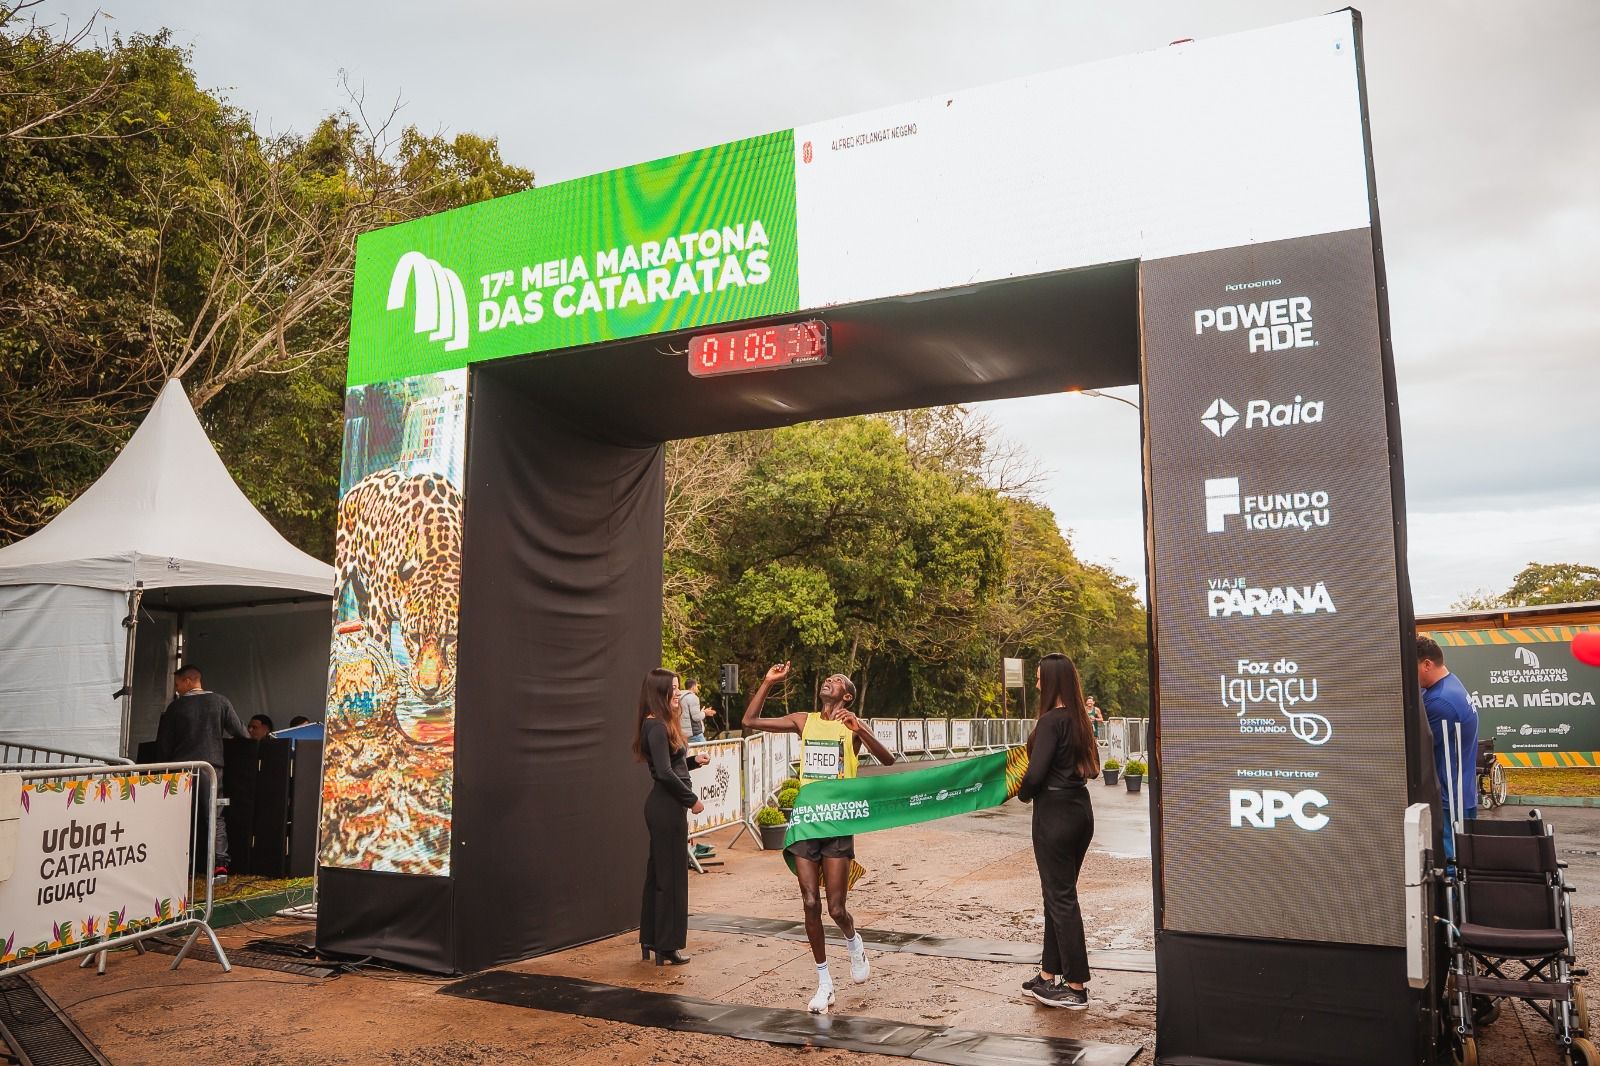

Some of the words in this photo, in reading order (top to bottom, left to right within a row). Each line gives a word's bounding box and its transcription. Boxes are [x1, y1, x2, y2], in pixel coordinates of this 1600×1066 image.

[831, 137, 855, 151] ALFRED
[521, 255, 589, 291] MEIA
[596, 220, 770, 278] MARATONA
[478, 291, 544, 332] DAS
[552, 250, 771, 318] CATARATAS
[1194, 296, 1313, 334] POWER
[1245, 395, 1324, 429] Raia
[1244, 490, 1329, 513] FUNDO
[1244, 508, 1330, 531] IGUAÇU
[1208, 577, 1247, 590] VIAJE
[1208, 581, 1337, 618] PARANÁ
[1237, 659, 1270, 675] Foz
[1273, 658, 1298, 674] do
[1502, 669, 1521, 677] MEIA
[1523, 668, 1568, 676] MARATONA
[1490, 676, 1510, 684] DAS
[1512, 674, 1569, 683] CATARATAS
[1220, 675, 1319, 716] Iguaçu
[1471, 690, 1519, 708] ÁREA
[1523, 688, 1597, 707] MÉDICA
[1239, 718, 1276, 726] DESTINO
[1237, 769, 1273, 777] Media
[1274, 769, 1320, 778] Partner
[792, 805, 814, 816] MEIA
[815, 799, 869, 813] MARATONA
[803, 807, 870, 824] CATARATAS
[1229, 789, 1330, 832] RPC
[40, 842, 147, 880] CATARATAS
[37, 877, 97, 906] IGUAÇU
